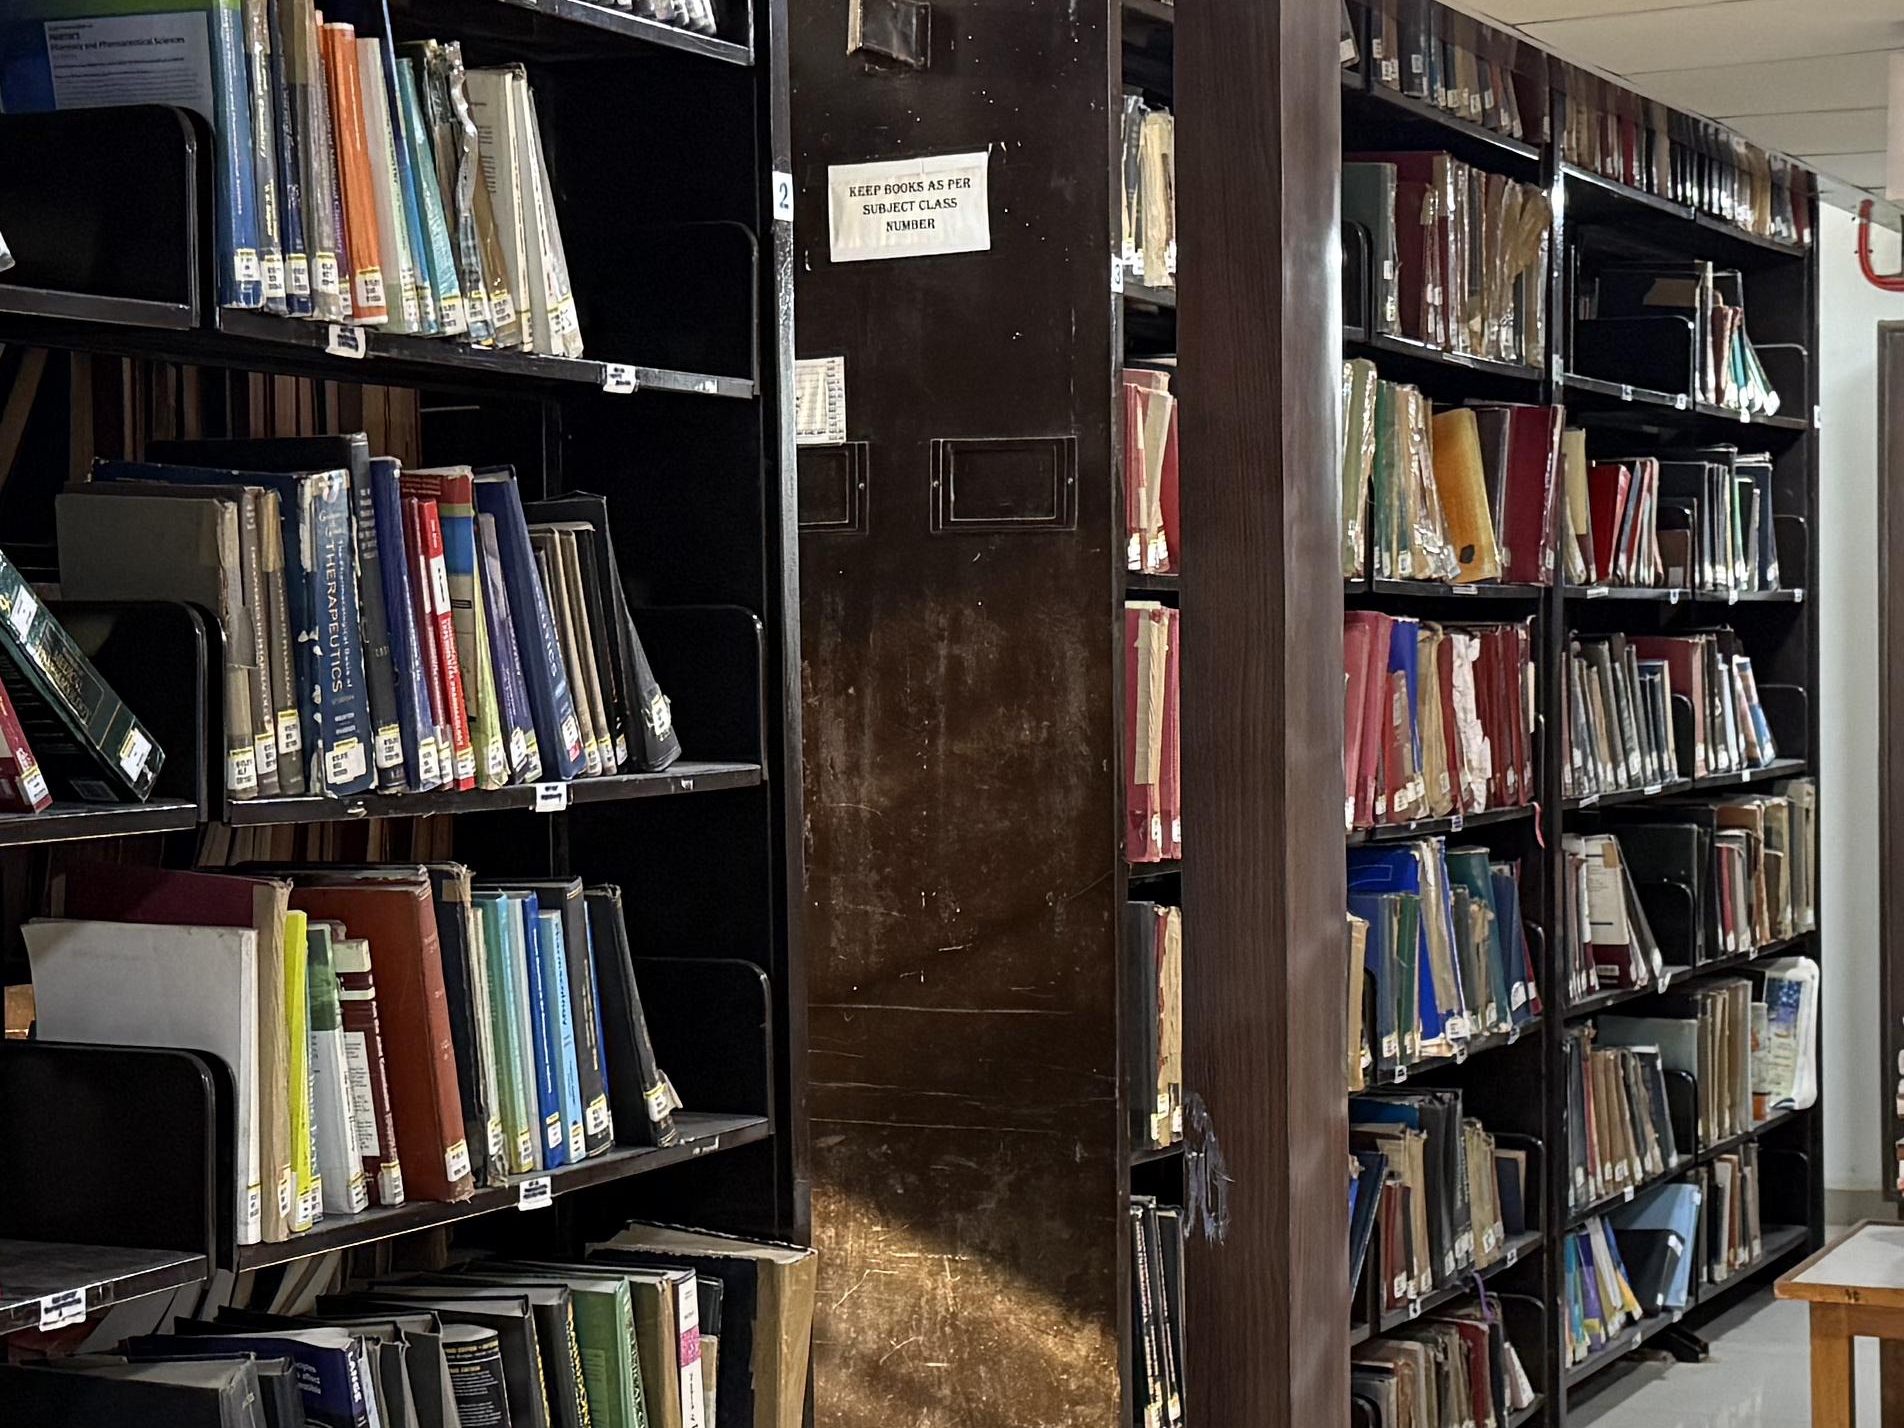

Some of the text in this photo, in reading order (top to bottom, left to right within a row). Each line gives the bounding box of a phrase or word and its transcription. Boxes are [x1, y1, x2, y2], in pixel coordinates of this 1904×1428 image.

[779, 183, 789, 210] 2
[849, 177, 972, 198] KEEP BOOKS AS PER
[862, 197, 958, 215] SUBJECT CLASS
[886, 218, 936, 233] NUMBER
[1114, 264, 1121, 284] 3
[325, 539, 343, 694] THERAPEUTICS
